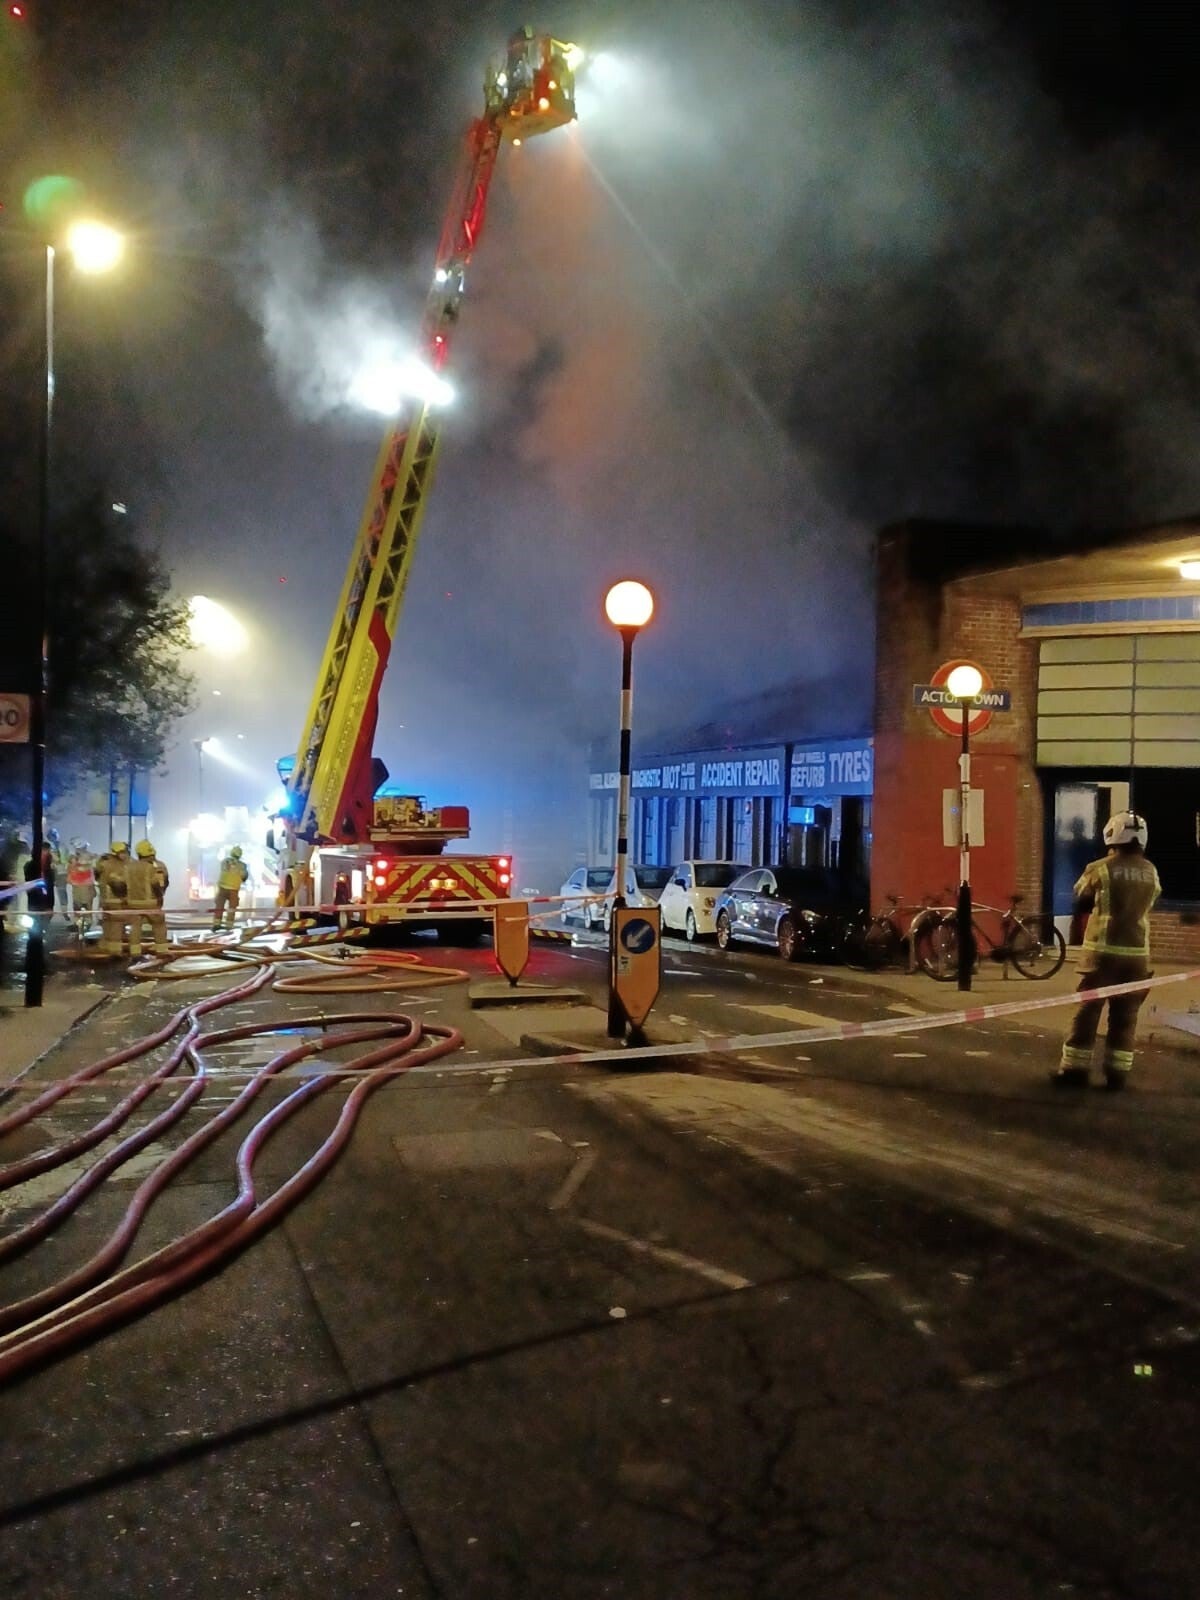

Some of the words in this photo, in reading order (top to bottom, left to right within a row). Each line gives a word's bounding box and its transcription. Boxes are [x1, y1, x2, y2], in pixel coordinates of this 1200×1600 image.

[974, 693, 1004, 706] OWN
[662, 765, 680, 789] MOT
[701, 761, 743, 787] ACCIDENT
[744, 758, 780, 786] REPAIR
[790, 766, 825, 788] REFURB
[829, 750, 870, 783] TYRES
